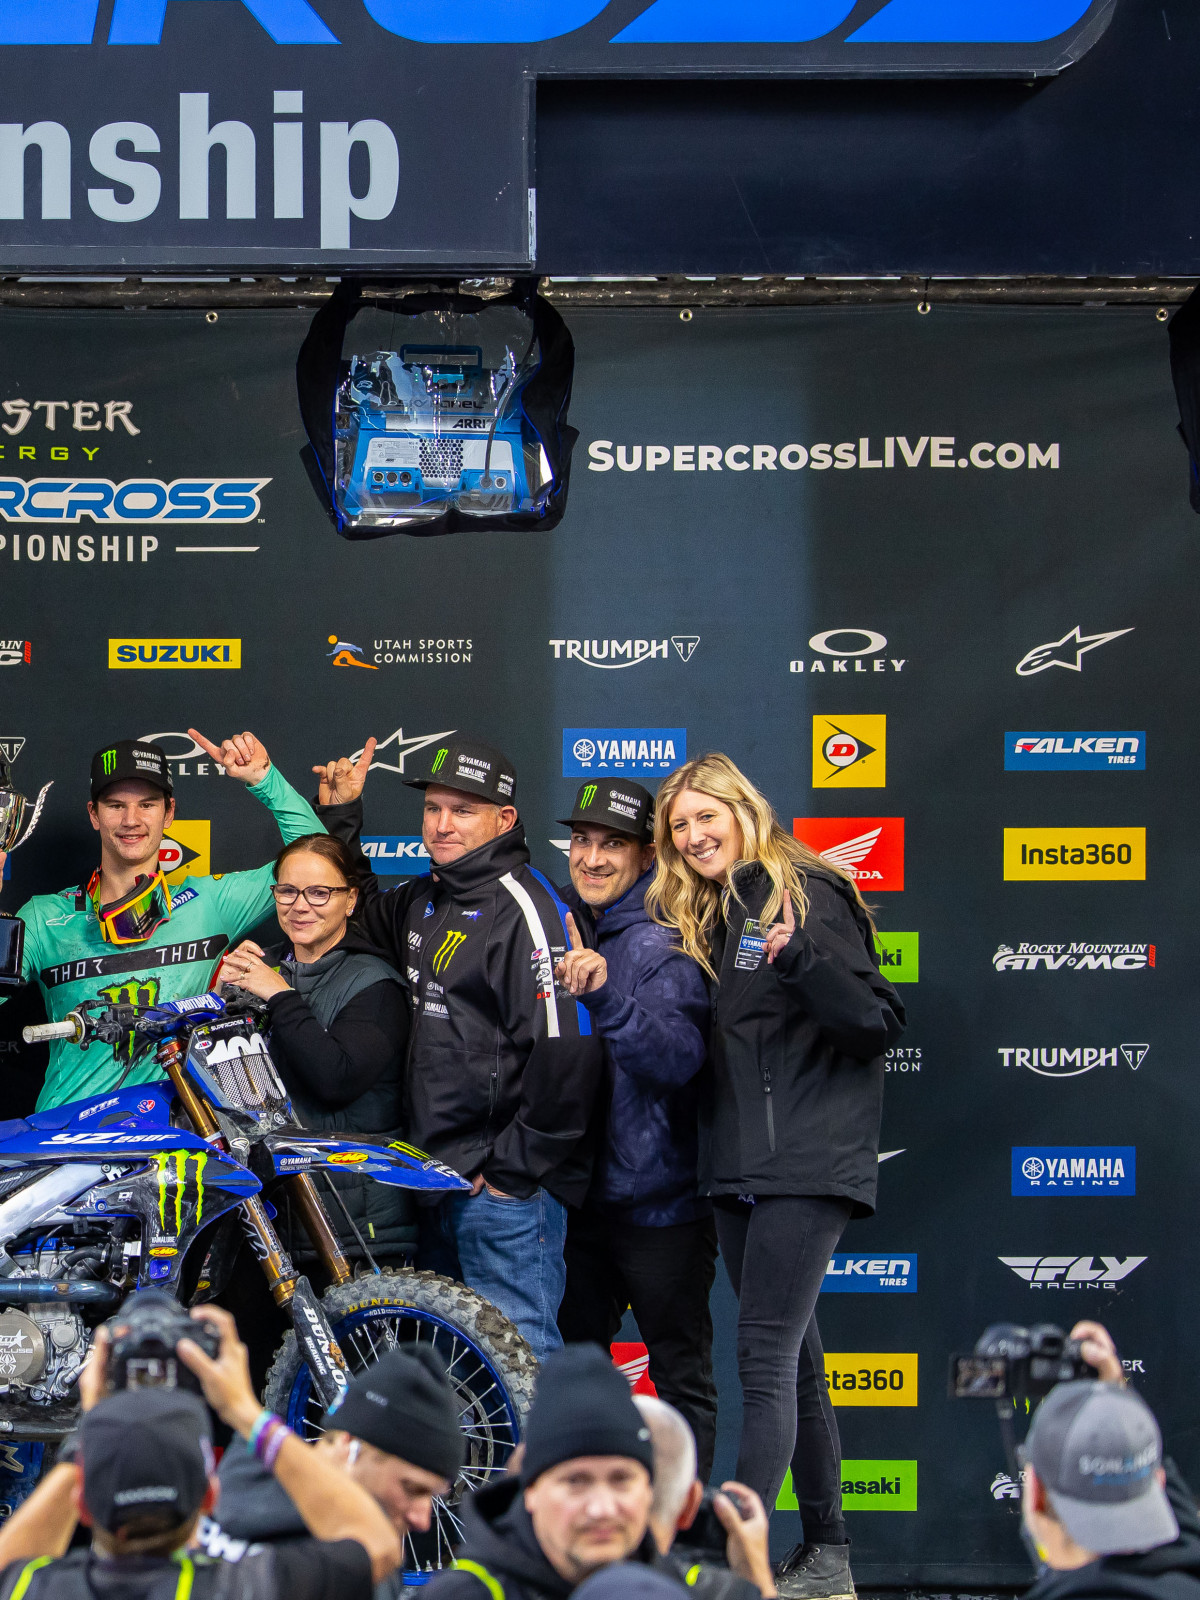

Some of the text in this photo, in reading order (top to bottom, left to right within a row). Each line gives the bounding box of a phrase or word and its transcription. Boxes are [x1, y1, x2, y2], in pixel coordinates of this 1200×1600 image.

[452, 418, 486, 429] ARRI
[374, 639, 473, 650] UTAH SPORTS
[550, 639, 668, 663] TRIUMPH
[117, 645, 231, 664] SUZUKI
[374, 652, 472, 664] COMMISSION
[790, 660, 906, 673] OAKLEY
[595, 740, 676, 760] YAMAHA
[1012, 737, 1139, 754] FALKEN
[139, 751, 162, 762] YAMAHA
[466, 756, 491, 771] YAMAHA
[1107, 755, 1136, 764] TIRES
[617, 792, 641, 808] YAMAHA
[1021, 843, 1132, 865] Insta360
[845, 870, 884, 880] NDA
[170, 890, 195, 909] MAHA
[1017, 942, 1147, 955] ROCKY MOUNTAIN
[885, 1048, 922, 1058] ORTS
[998, 1047, 1118, 1071] TRIUMPH
[79, 1097, 120, 1121] GYTR
[286, 1157, 312, 1165] YAMAHA
[1045, 1157, 1125, 1178] YAMAHA
[825, 1259, 911, 1275] LKEN
[1029, 1256, 1147, 1281] FLY
[879, 1277, 908, 1286] TIRES
[348, 1297, 417, 1313] DUNLOP
[303, 1306, 349, 1391] DUNLO
[304, 1336, 327, 1376] BRAKING
[824, 1369, 904, 1391] sta360
[841, 1477, 901, 1495] asaki
